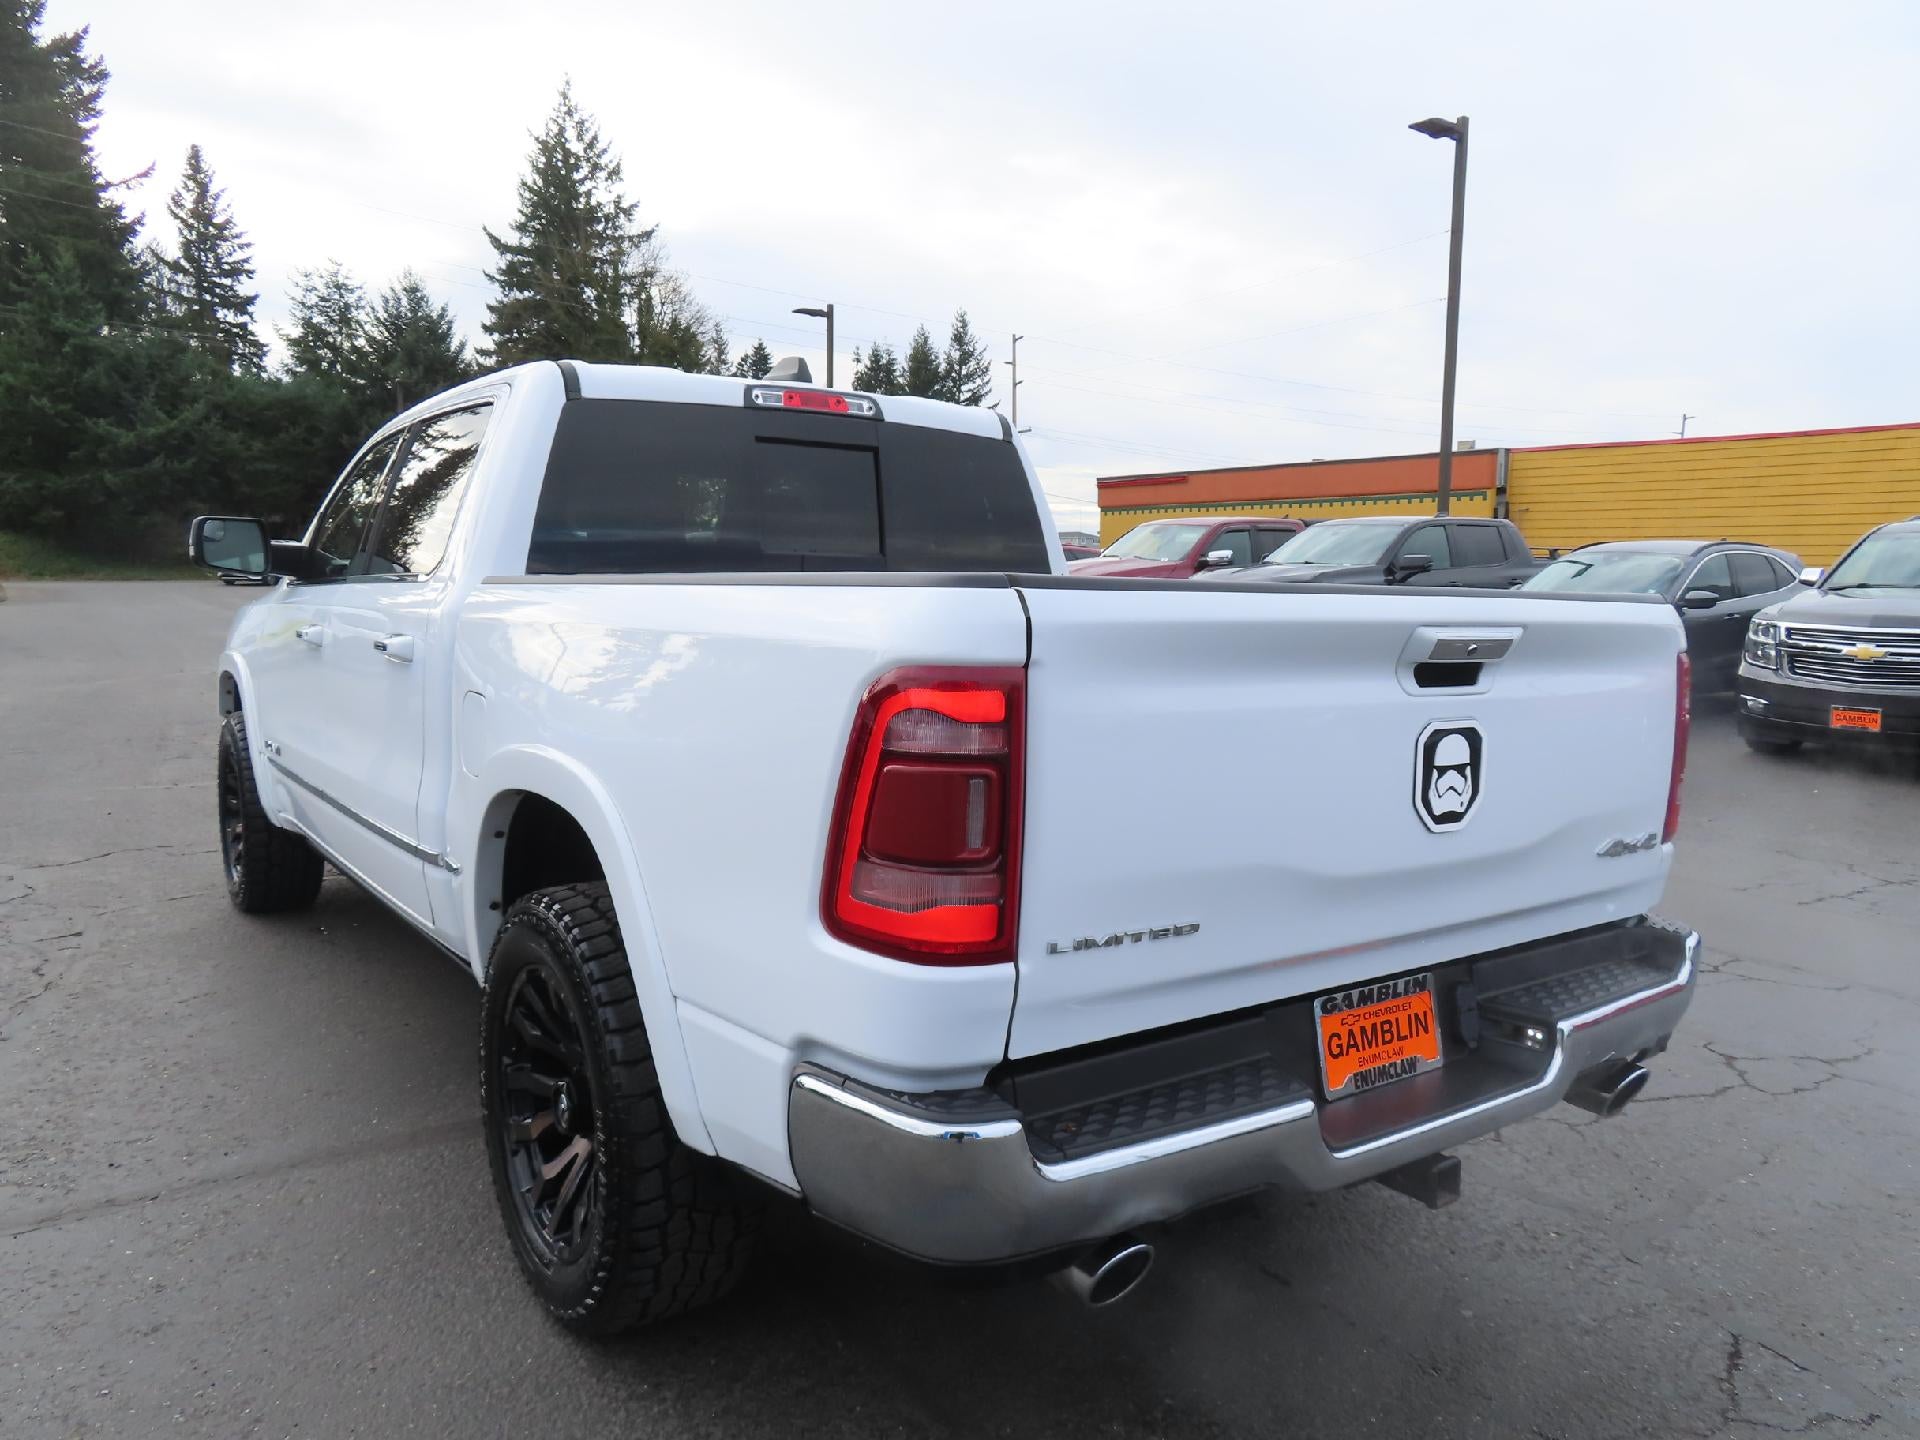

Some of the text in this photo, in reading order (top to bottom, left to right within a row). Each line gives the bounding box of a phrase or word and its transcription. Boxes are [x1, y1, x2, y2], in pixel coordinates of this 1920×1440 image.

[1047, 923, 1200, 954] LIMITED
[1320, 975, 1428, 1015] GAMBLIN
[1363, 1001, 1413, 1020] CHEVROLET
[1327, 1010, 1429, 1060] GAMBLIN
[1357, 1046, 1405, 1067] ENUMCLAW
[1353, 1056, 1418, 1090] ENUMCLAW
